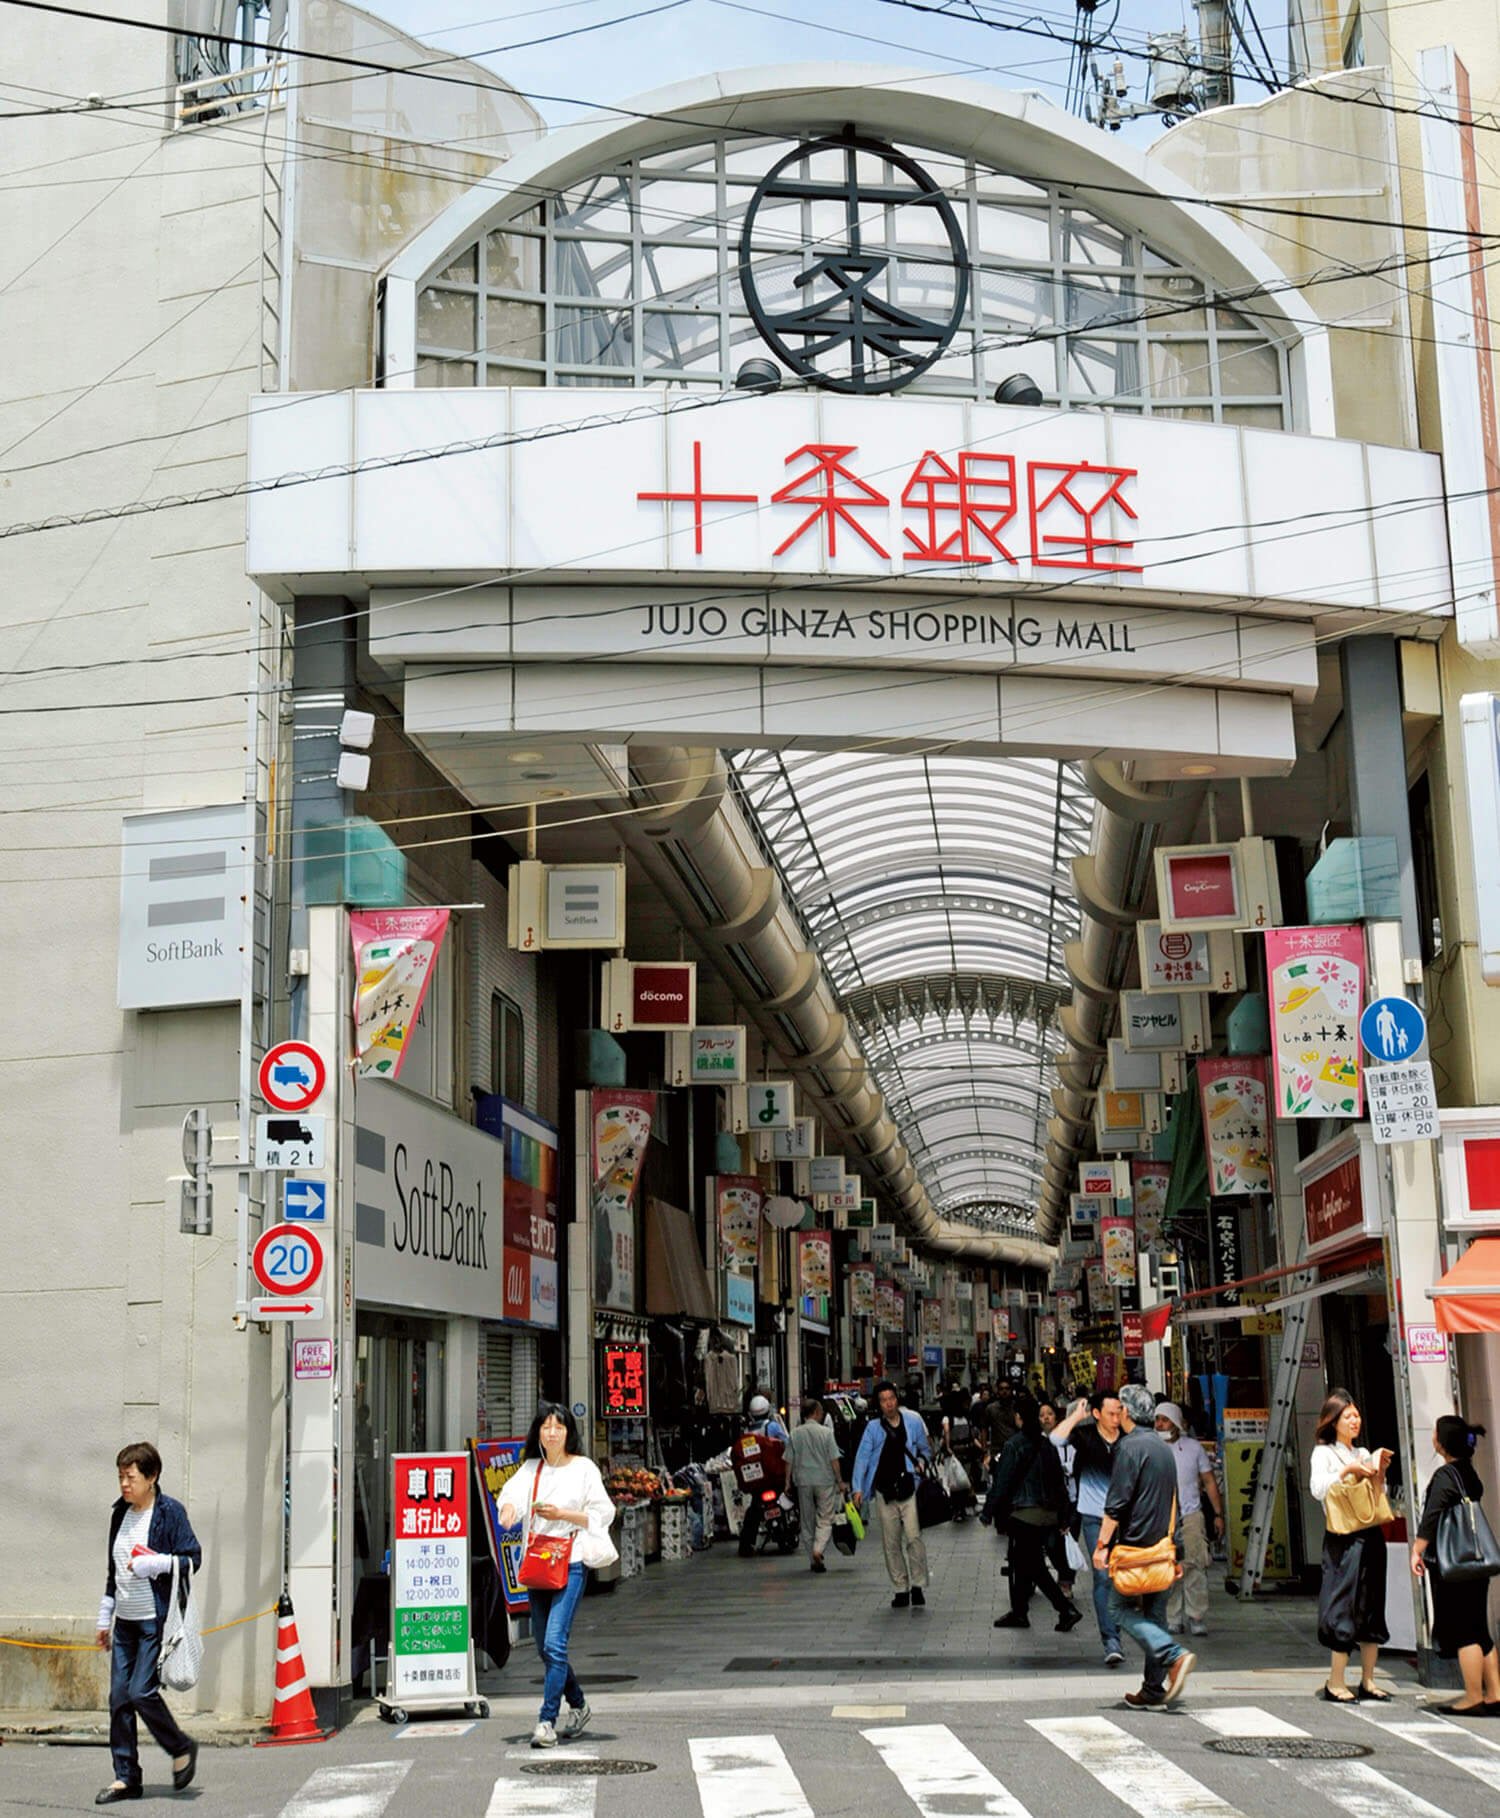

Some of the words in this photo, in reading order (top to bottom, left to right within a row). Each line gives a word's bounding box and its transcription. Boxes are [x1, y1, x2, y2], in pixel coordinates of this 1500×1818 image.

[637, 440, 1143, 573] 十条銀座
[641, 603, 727, 638] JUJO
[742, 606, 857, 642] GINZA
[868, 610, 1043, 649] SHOPPING
[1056, 619, 1137, 654] MALL
[564, 915, 598, 926] SoftBank
[146, 938, 224, 964] SoftBank
[639, 989, 684, 1002] docomo
[1131, 1013, 1178, 1029] ミツヤビル
[696, 1039, 735, 1050] フルーツ
[1369, 1069, 1428, 1085] 自転車を除く
[1376, 1099, 1389, 1111] 14
[1411, 1095, 1429, 1108] 20
[1379, 1126, 1393, 1139] 12
[1415, 1122, 1432, 1135] 20
[393, 1142, 487, 1270] SoftBank
[269, 1244, 309, 1277] 20
[301, 1344, 325, 1356] FREE
[402, 1507, 462, 1535] 通行止め
[420, 1543, 446, 1555] 平日
